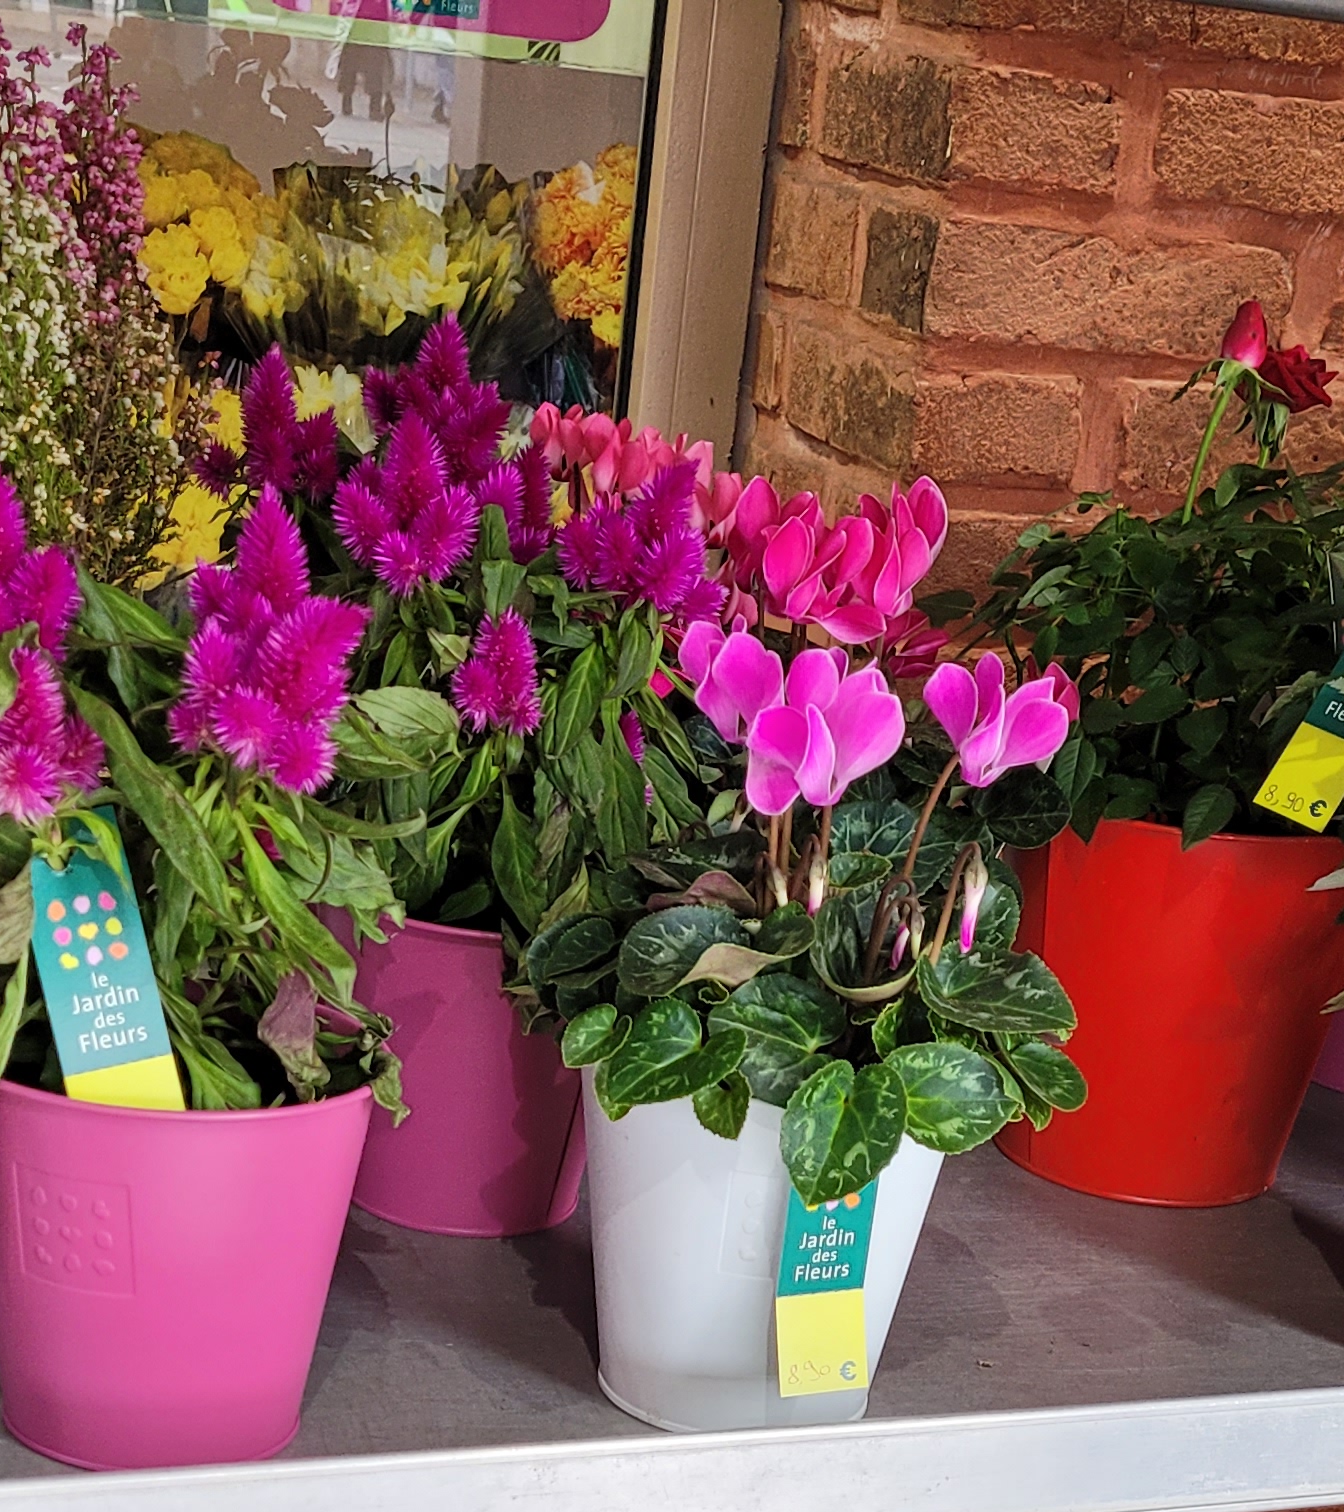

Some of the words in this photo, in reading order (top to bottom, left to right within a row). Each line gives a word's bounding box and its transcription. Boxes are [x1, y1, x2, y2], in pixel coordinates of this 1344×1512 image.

[441, 0, 474, 13] Fleurs
[1309, 799, 1328, 817] €
[91, 971, 109, 989] le
[71, 984, 140, 1015] Jardin
[94, 1009, 125, 1030] des
[78, 1023, 149, 1053] Fleurs
[822, 1215, 837, 1231] le
[799, 1229, 855, 1250] Jardin
[812, 1248, 838, 1264] des
[794, 1262, 851, 1283] Fleurs
[839, 1360, 857, 1382] €
